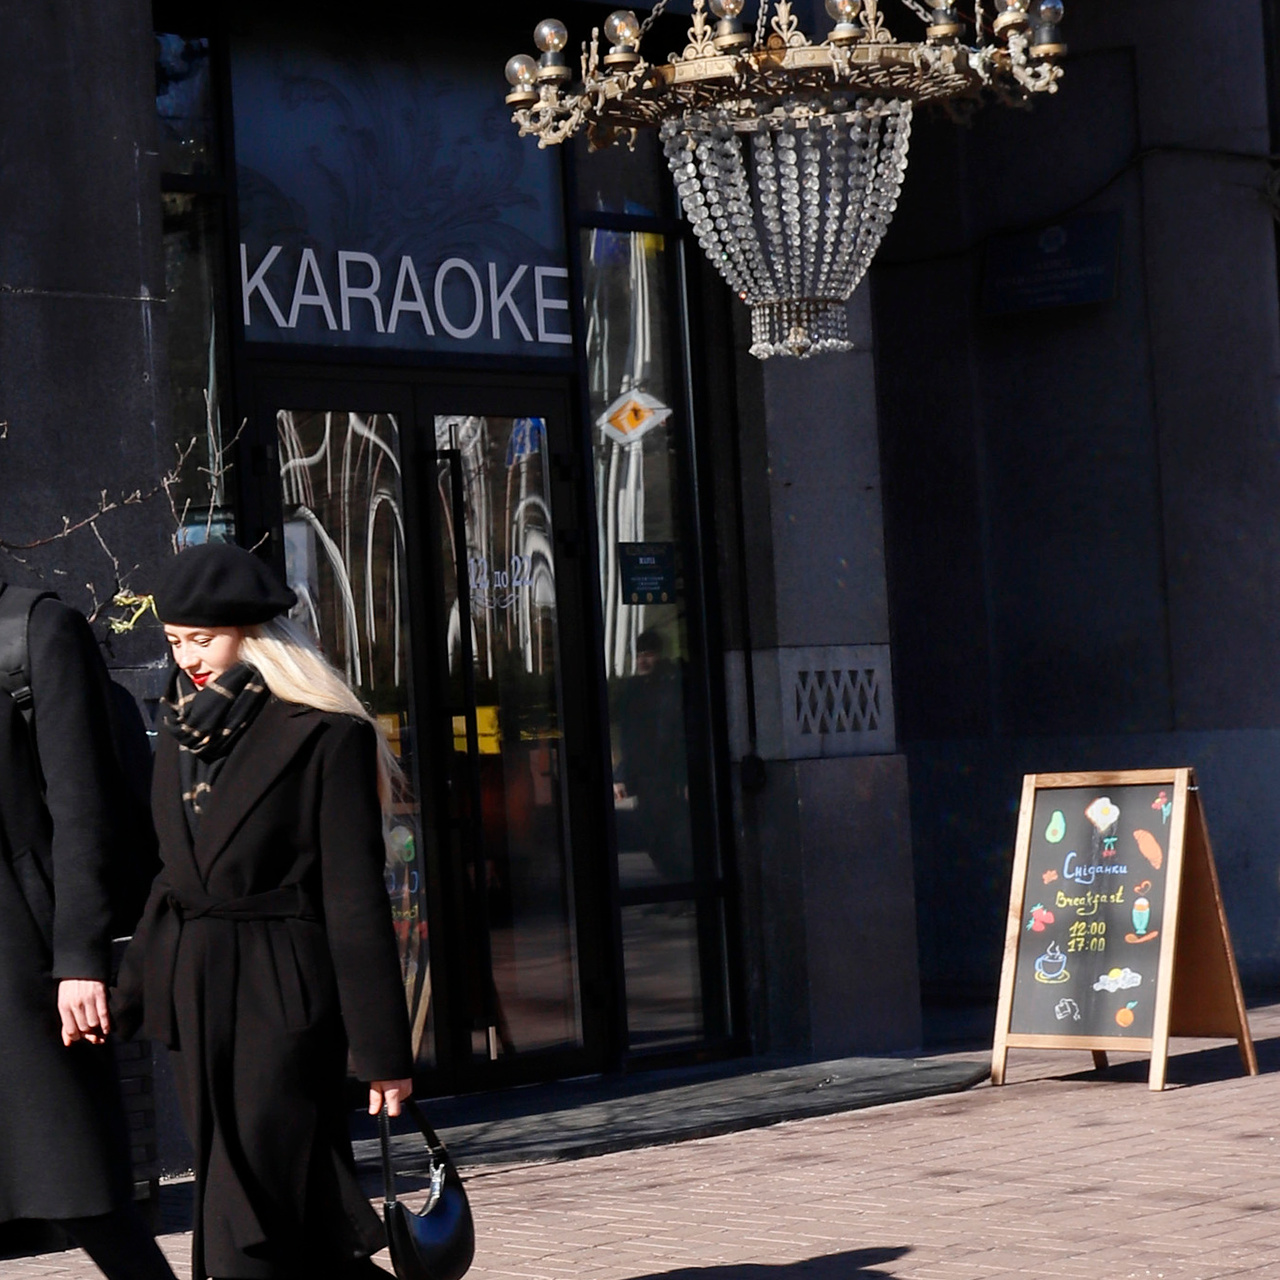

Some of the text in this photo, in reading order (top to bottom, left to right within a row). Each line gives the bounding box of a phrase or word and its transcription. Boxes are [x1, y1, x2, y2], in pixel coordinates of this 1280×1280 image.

[240, 243, 573, 345] KARAOKE
[1055, 885, 1125, 915] Breakfast
[1069, 921, 1106, 937] 12:00
[1067, 937, 1106, 953] 17:00
